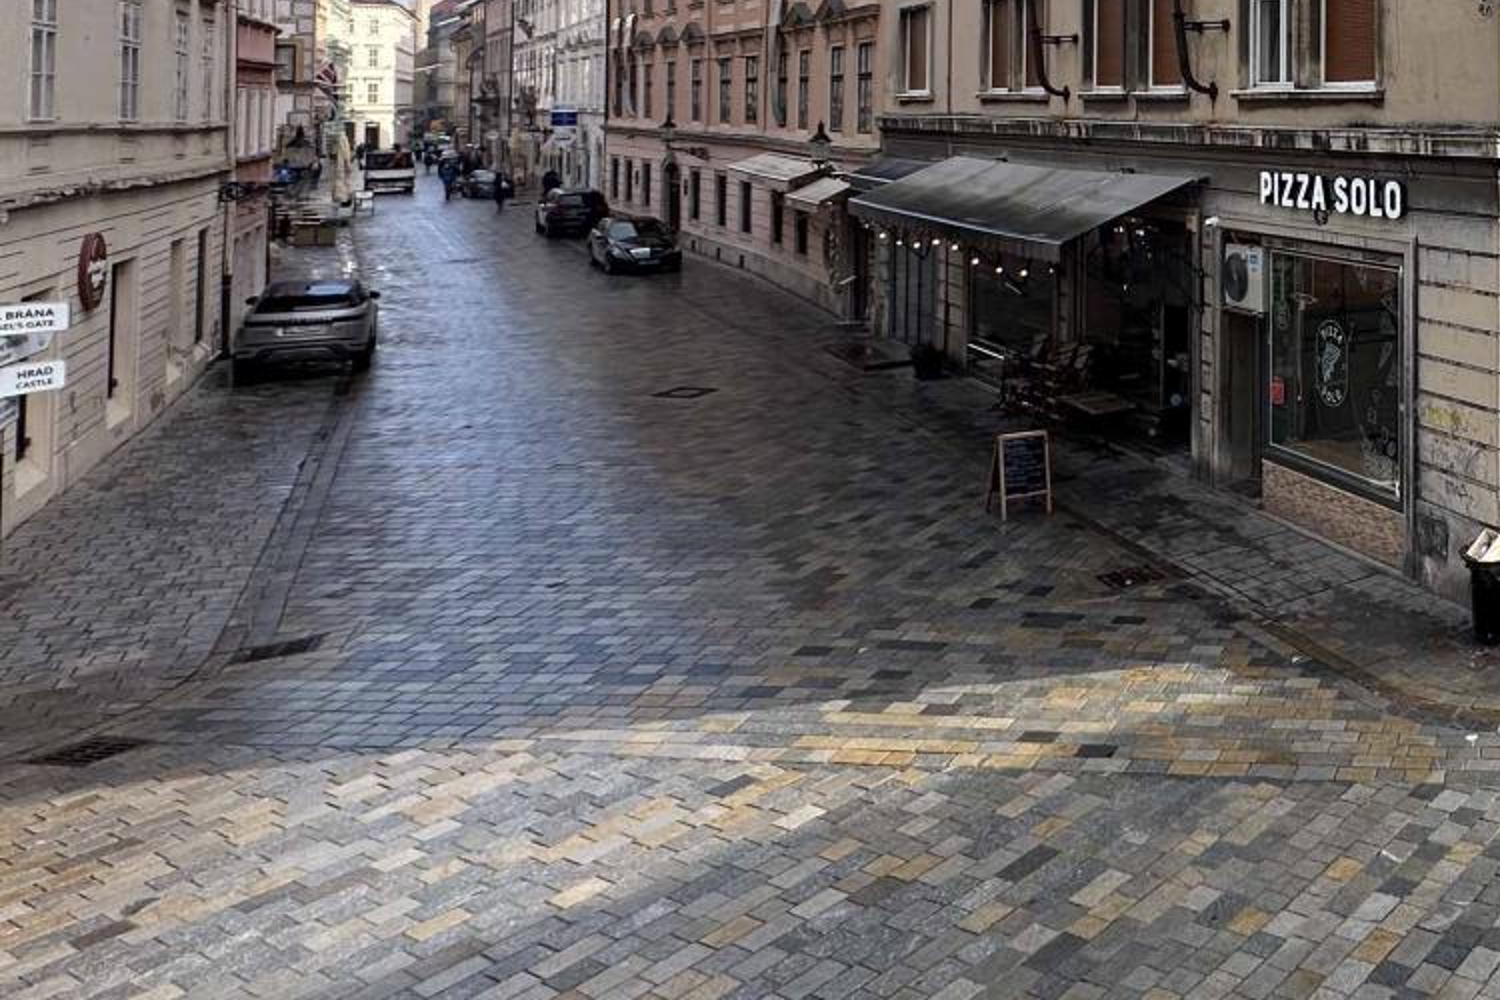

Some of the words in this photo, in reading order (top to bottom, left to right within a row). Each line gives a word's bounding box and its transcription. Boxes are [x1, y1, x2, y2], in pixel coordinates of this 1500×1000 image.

[1259, 171, 1327, 211] PIZZA
[1333, 175, 1402, 219] SOLO
[25, 319, 54, 328] GATE
[16, 366, 54, 379] HRAD
[15, 378, 53, 389] CASTLE
